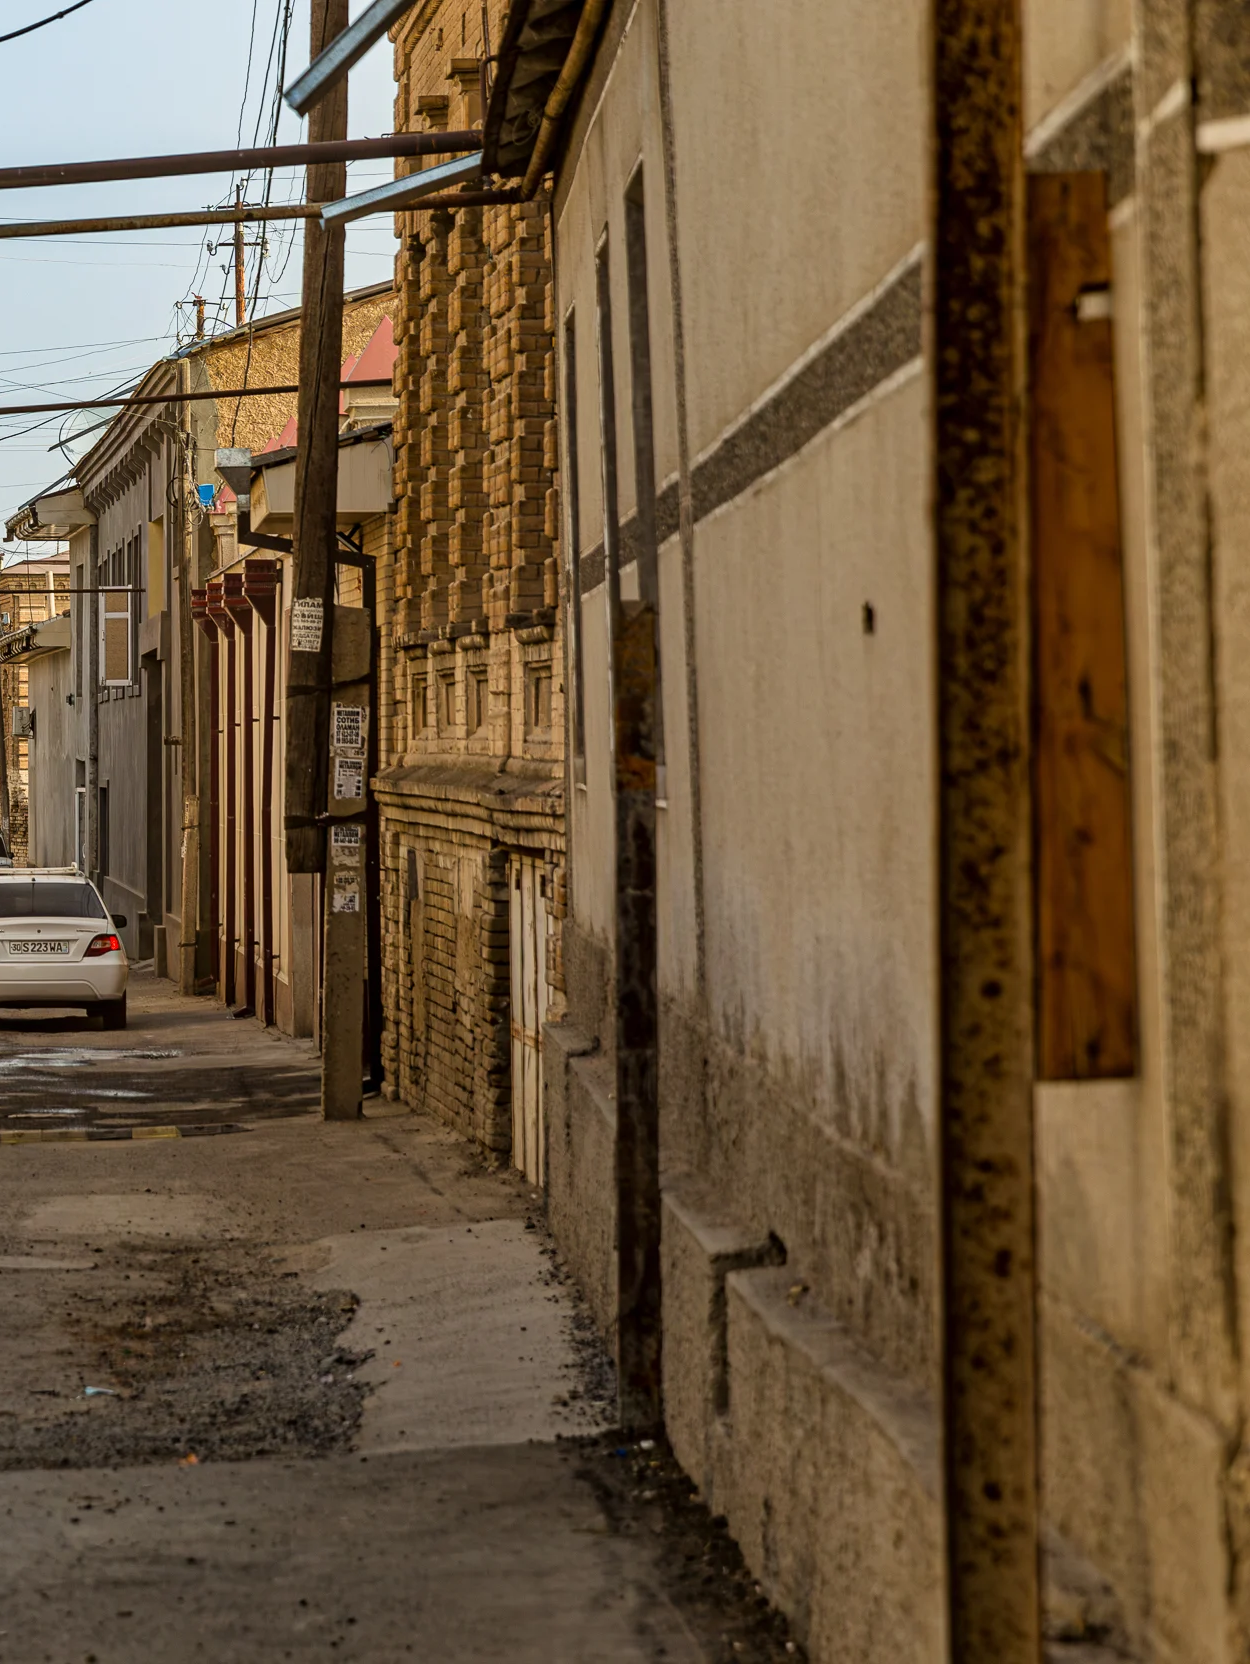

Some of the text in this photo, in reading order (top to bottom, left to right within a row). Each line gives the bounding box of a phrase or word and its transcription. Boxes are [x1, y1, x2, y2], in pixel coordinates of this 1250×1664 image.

[11, 943, 21, 952] 30
[30, 943, 48, 952] 223
[49, 943, 63, 953] WA
